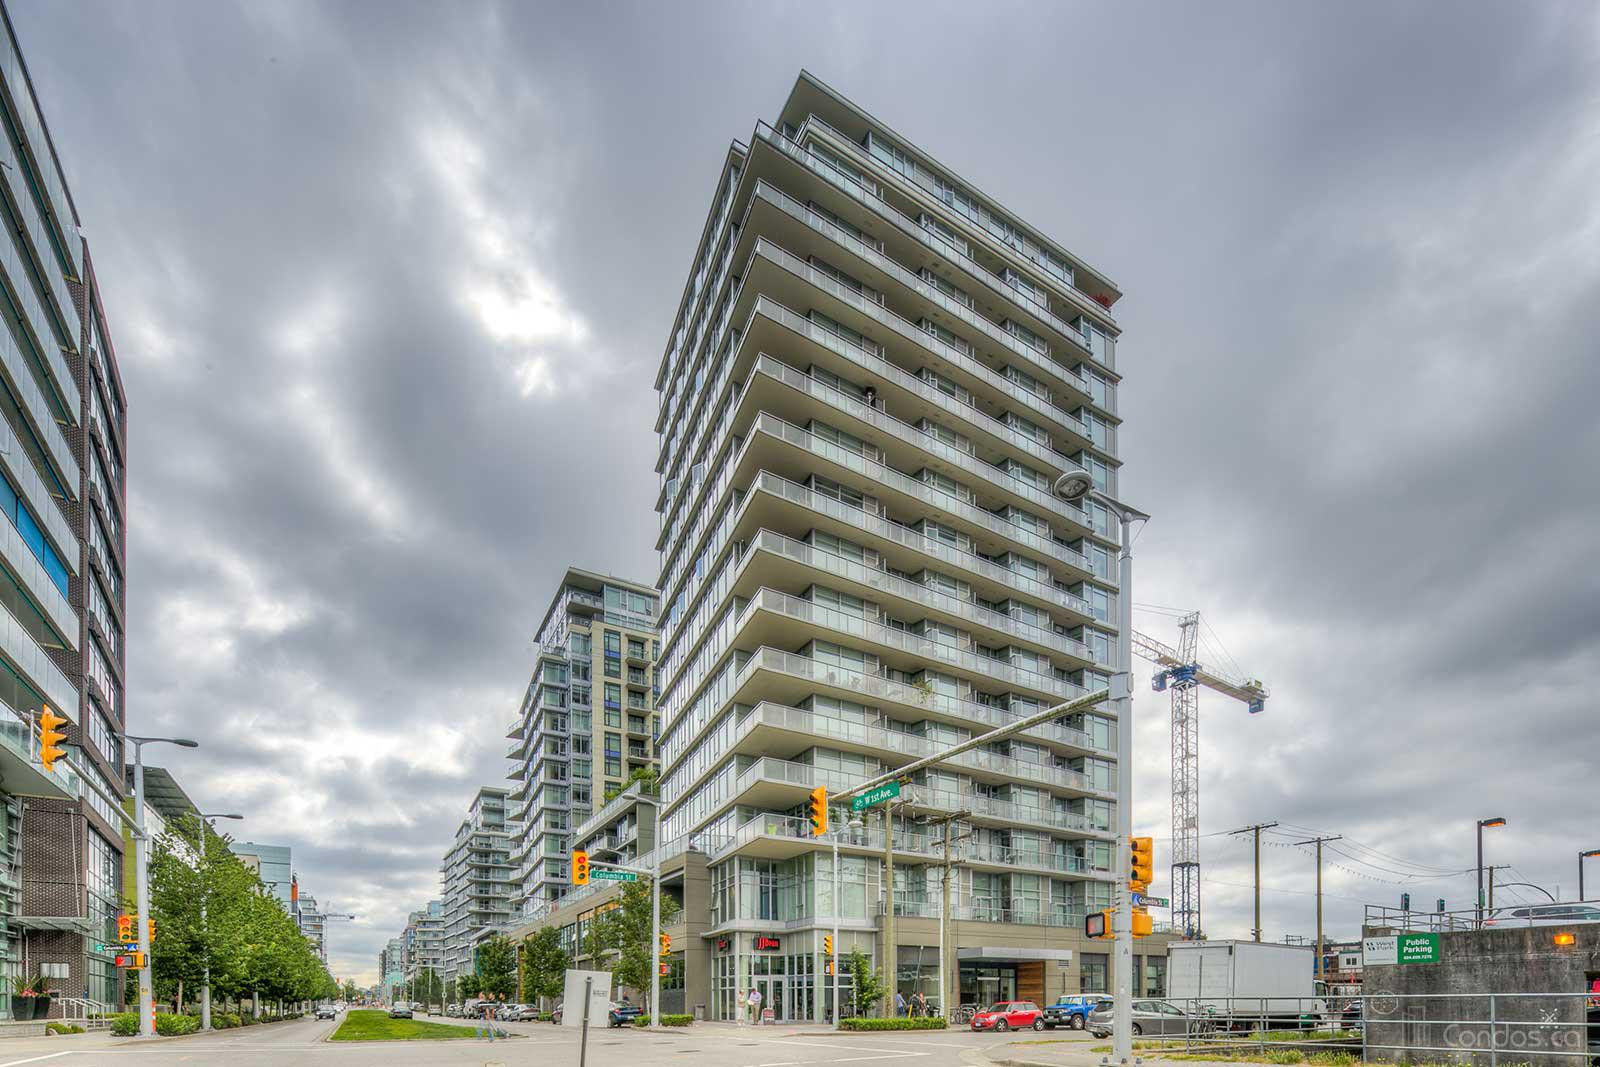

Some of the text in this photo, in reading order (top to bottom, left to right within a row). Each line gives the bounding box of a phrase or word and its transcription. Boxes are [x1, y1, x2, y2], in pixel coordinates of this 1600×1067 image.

[871, 792, 880, 803] 1st
[880, 789, 893, 799] Ave.
[595, 871, 624, 880] Columbia
[1405, 938, 1430, 946] Public
[1403, 946, 1433, 954] Parking
